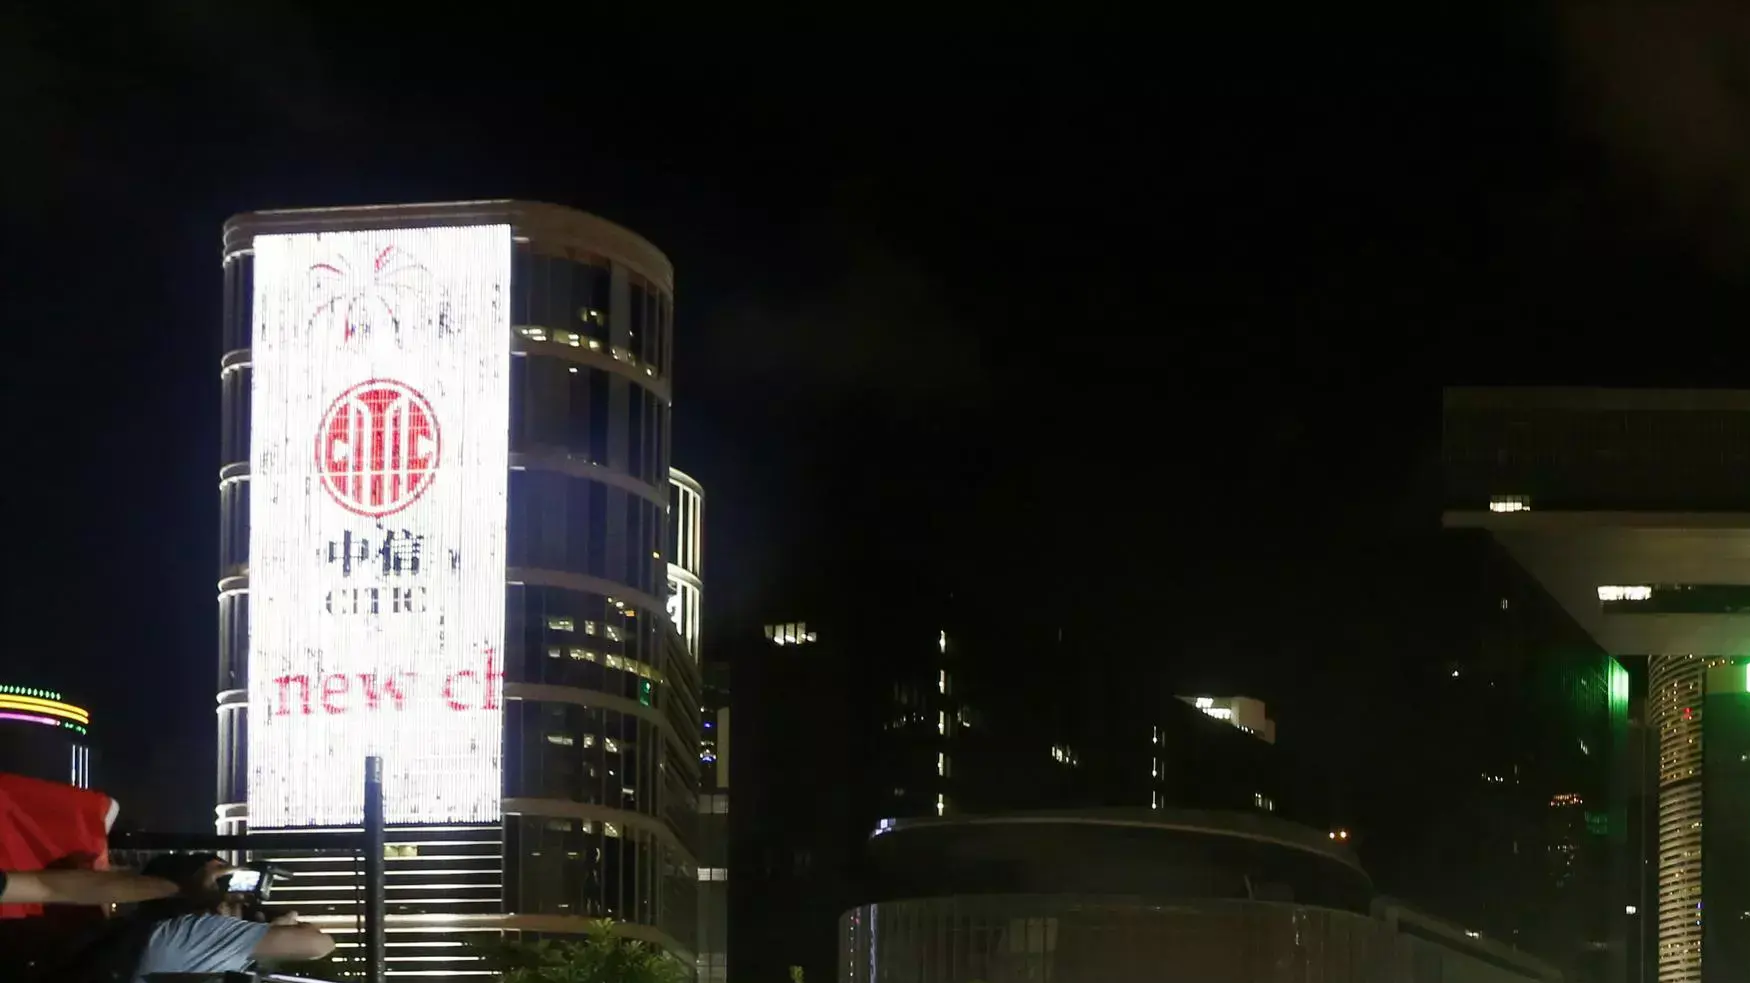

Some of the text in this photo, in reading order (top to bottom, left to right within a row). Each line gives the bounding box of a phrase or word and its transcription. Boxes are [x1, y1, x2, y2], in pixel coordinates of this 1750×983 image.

[326, 528, 424, 577] 中信
[325, 586, 427, 615] CITIC
[275, 670, 417, 716] new
